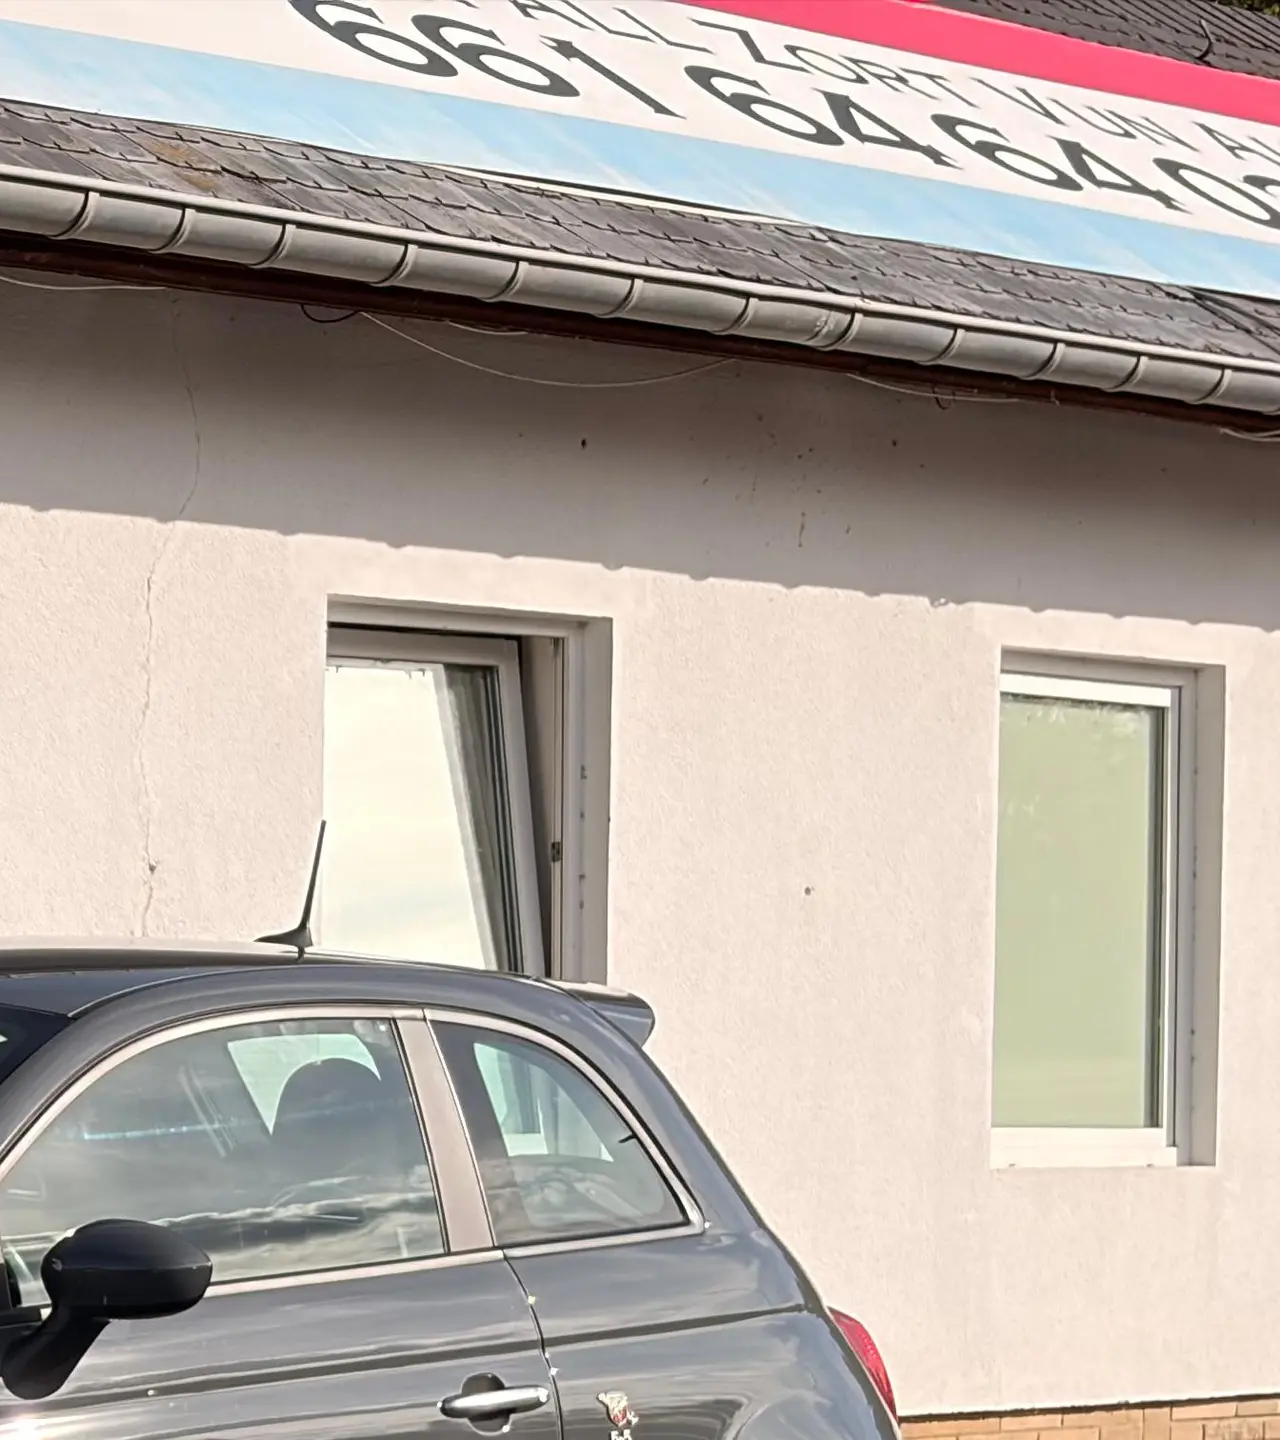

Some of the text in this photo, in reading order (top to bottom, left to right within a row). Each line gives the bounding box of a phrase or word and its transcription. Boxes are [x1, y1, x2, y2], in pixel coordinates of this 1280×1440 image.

[292, 0, 687, 119] 661
[683, 65, 965, 170] 64
[930, 112, 1194, 215] 64
[686, 17, 980, 108] ZORT
[970, 77, 1201, 152] VUN
